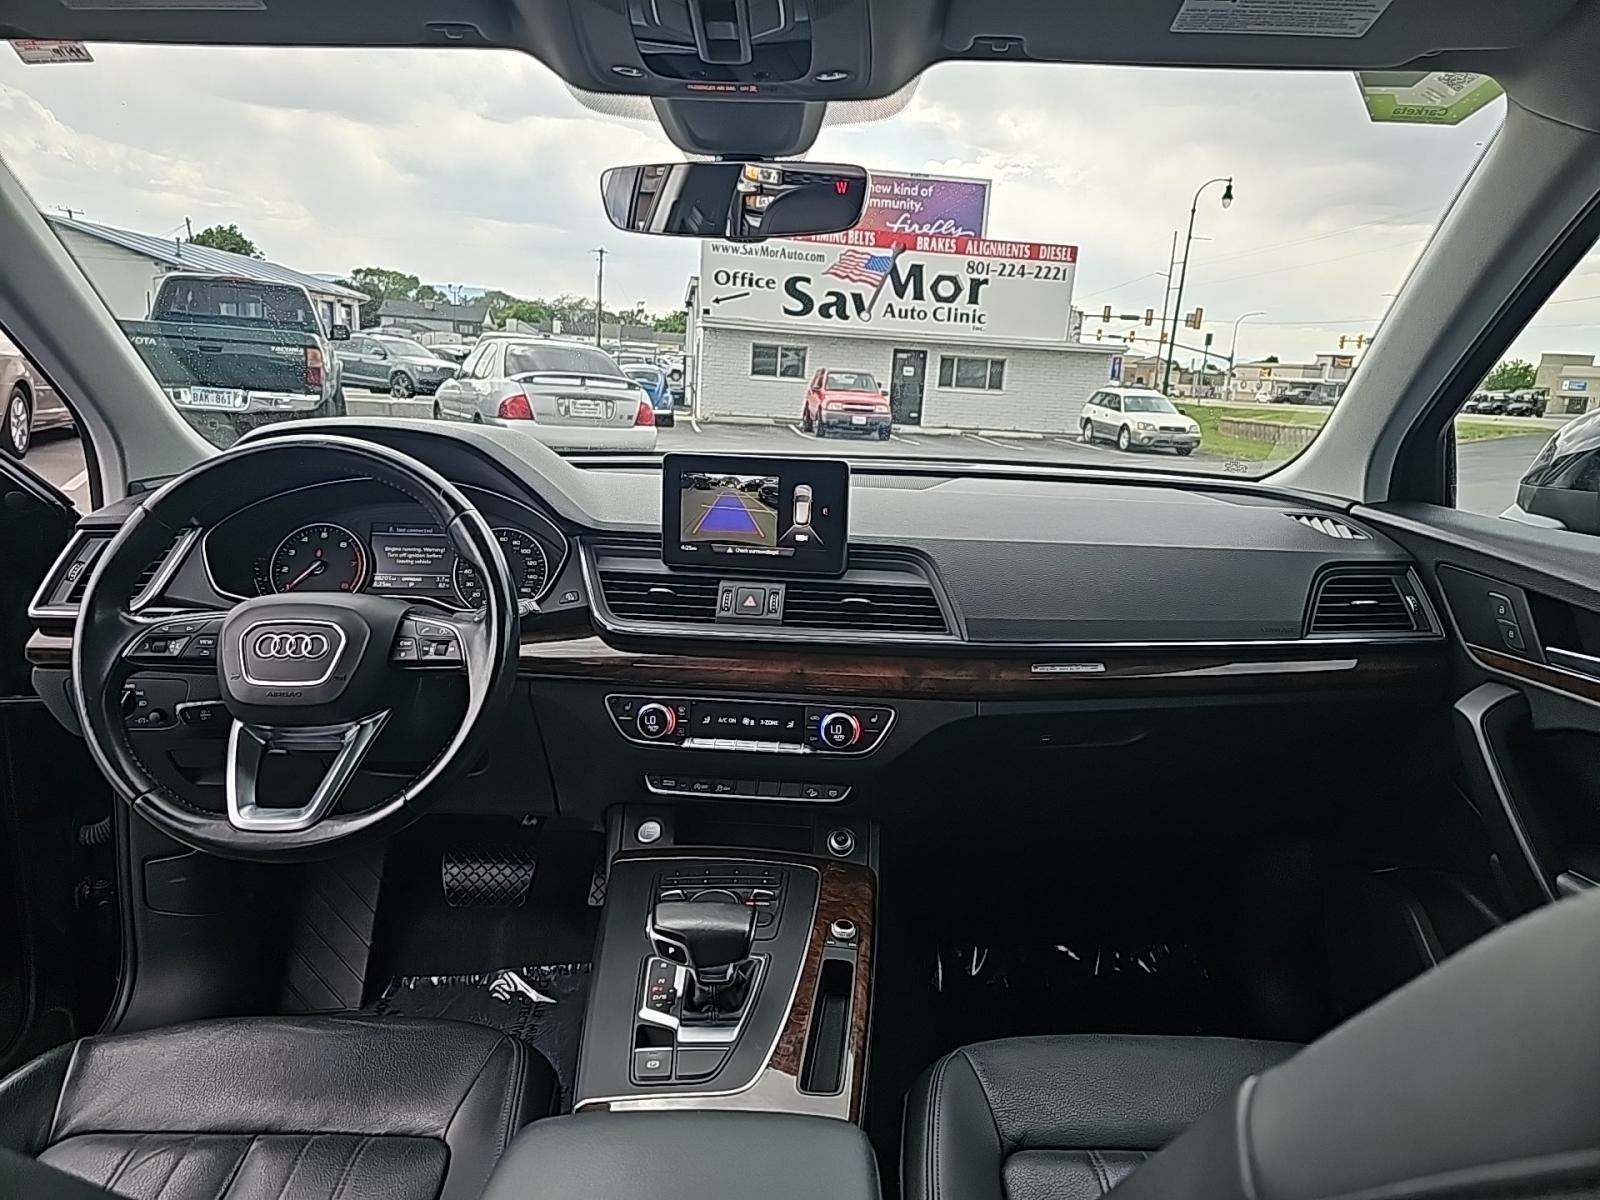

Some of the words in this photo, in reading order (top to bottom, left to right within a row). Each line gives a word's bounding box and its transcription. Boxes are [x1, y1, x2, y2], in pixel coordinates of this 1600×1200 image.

[836, 181, 848, 194] W
[893, 182, 919, 196] kind
[920, 186, 933, 198] of
[886, 213, 975, 237] firefly
[711, 243, 826, 263] www.SavMorAuto.com
[847, 229, 876, 246] BELTS
[916, 236, 957, 253] BRAKES
[965, 240, 1031, 258] ALIGNMENTS
[1039, 246, 1073, 261] DIESEL
[714, 270, 777, 290] Office
[966, 260, 1068, 281] 801-224-2221
[882, 303, 928, 321] Auto
[932, 307, 987, 325] Clinic
